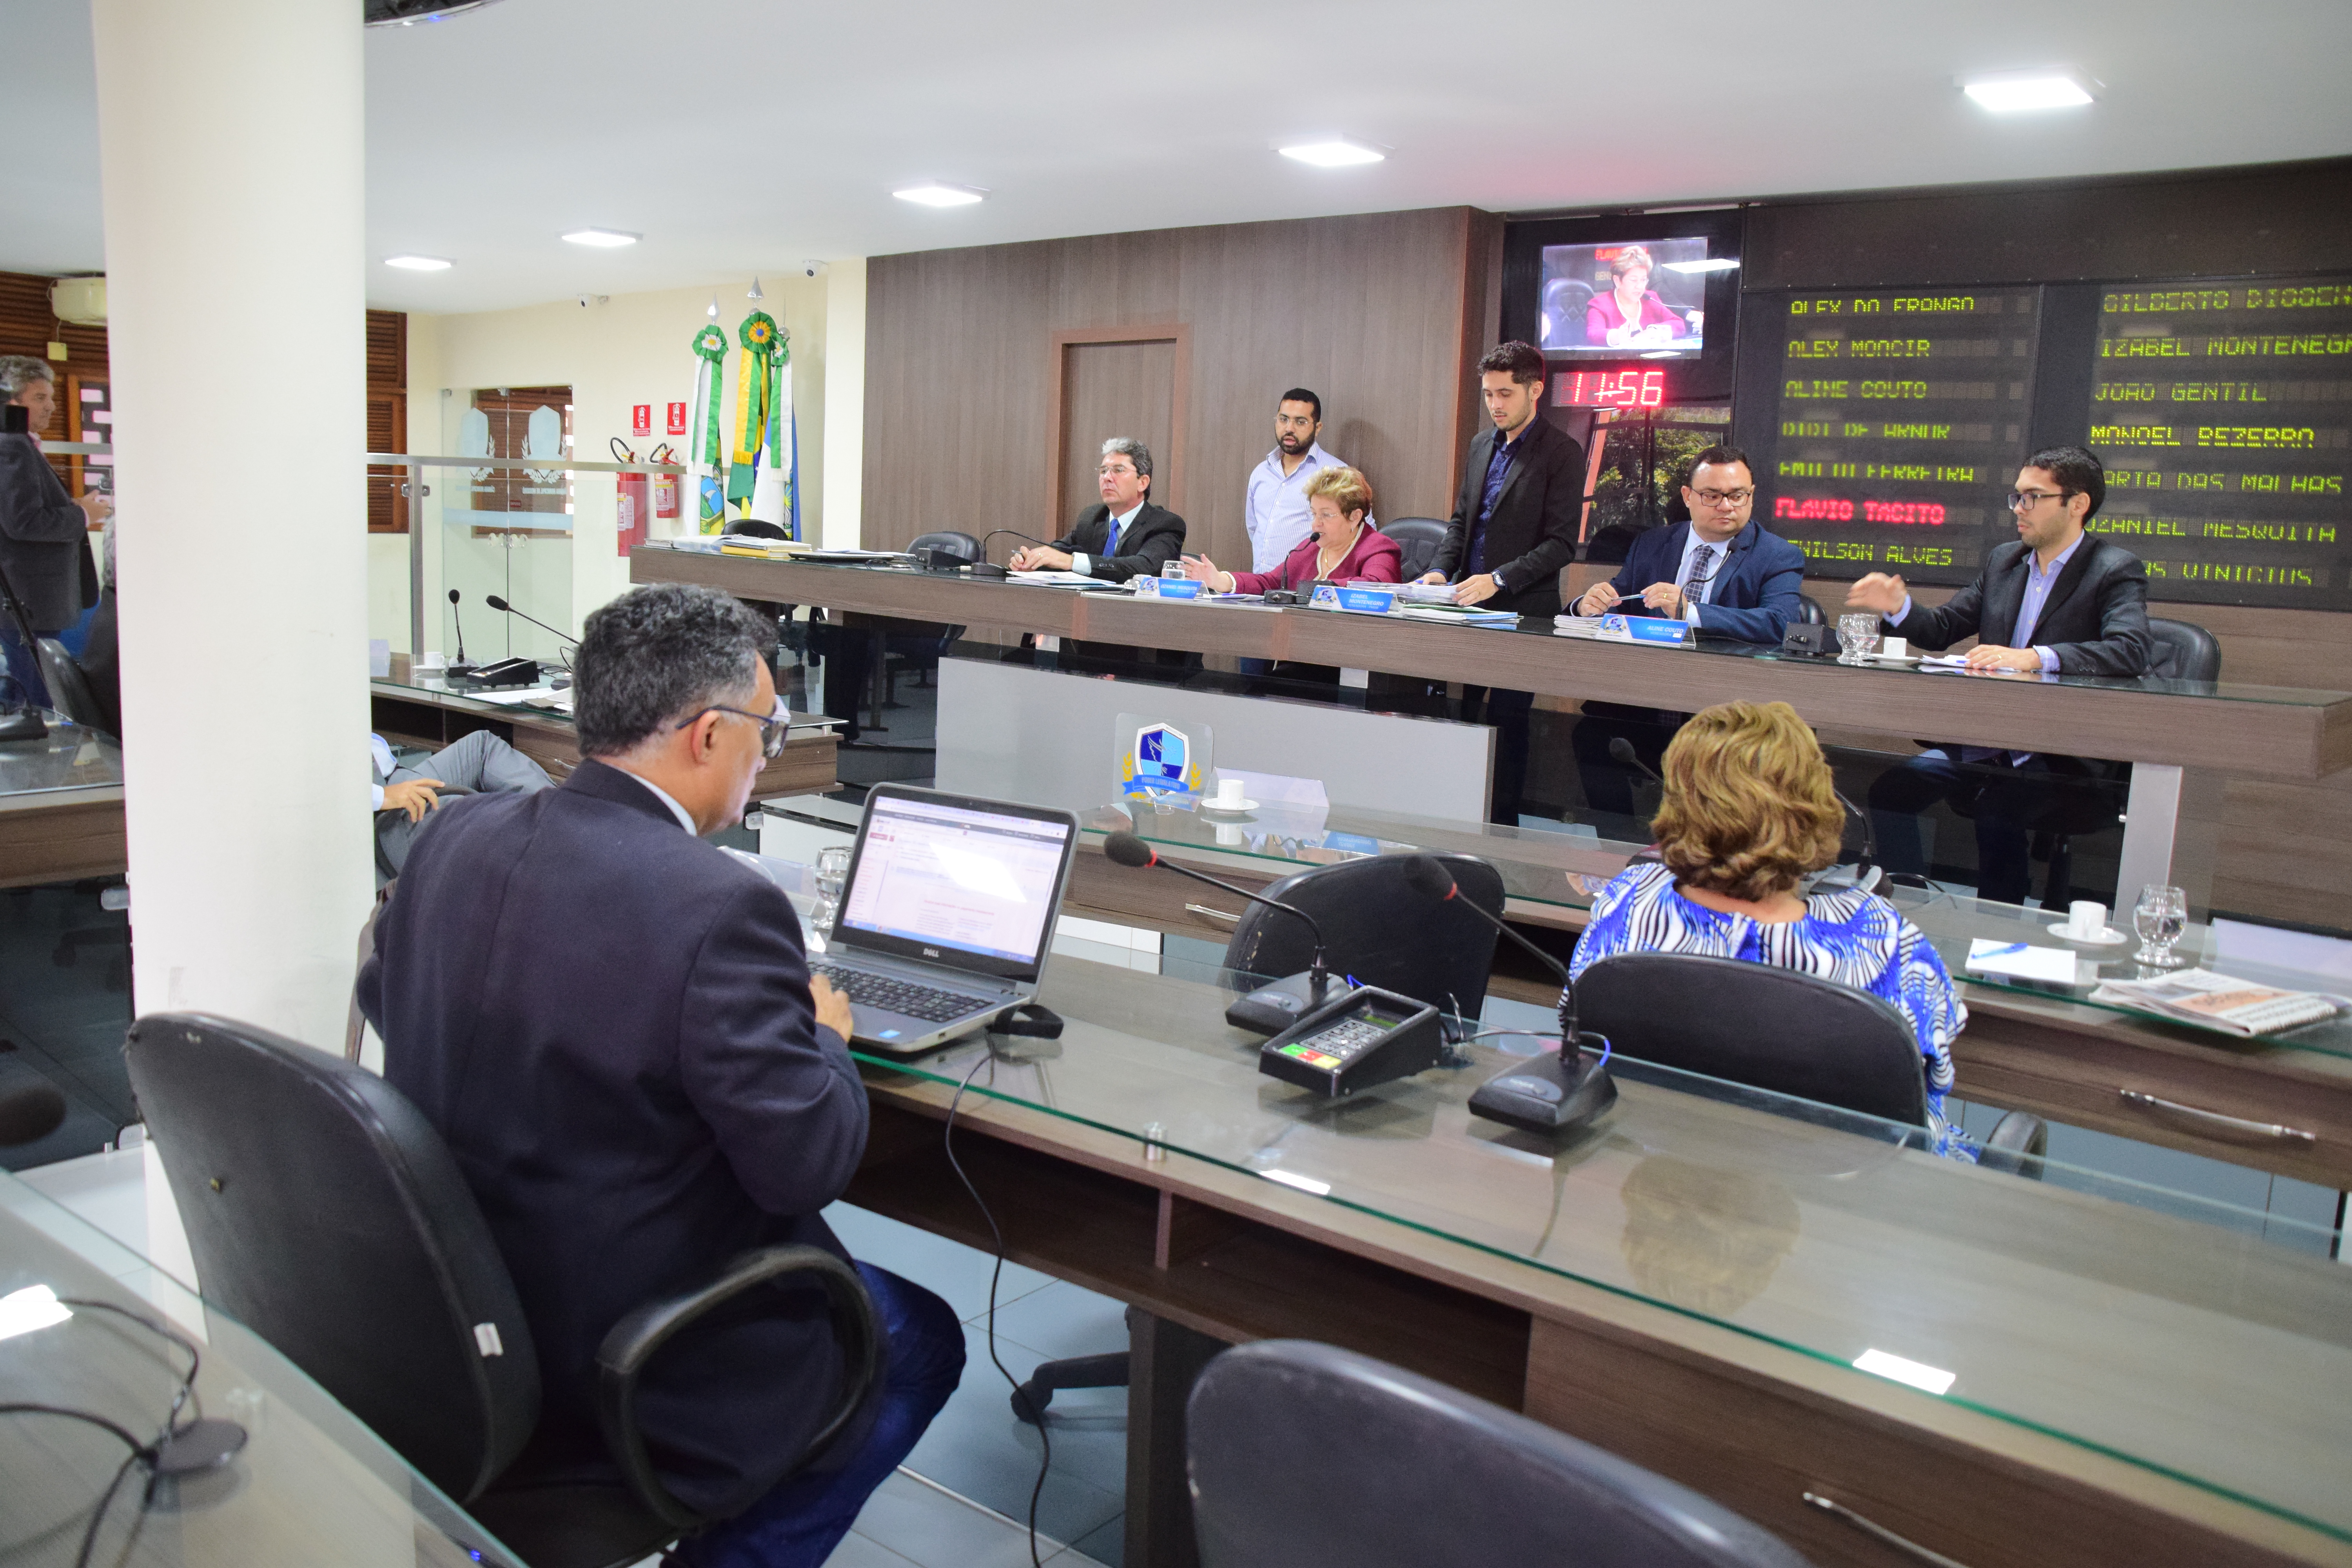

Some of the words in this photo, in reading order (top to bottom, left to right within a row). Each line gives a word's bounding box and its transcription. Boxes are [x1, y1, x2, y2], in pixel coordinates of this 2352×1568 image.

[2102, 338, 2190, 358] IZABEL
[1573, 371, 1664, 405] 11:56
[1785, 380, 1849, 399] ALINE
[1861, 380, 1928, 399] COUTO
[2171, 383, 2267, 402] GENTIL
[1775, 497, 1854, 521] FLAVIO
[1862, 500, 1945, 526] TACITO
[1885, 545, 1953, 566] ALVES
[924, 948, 939, 957] DELL
